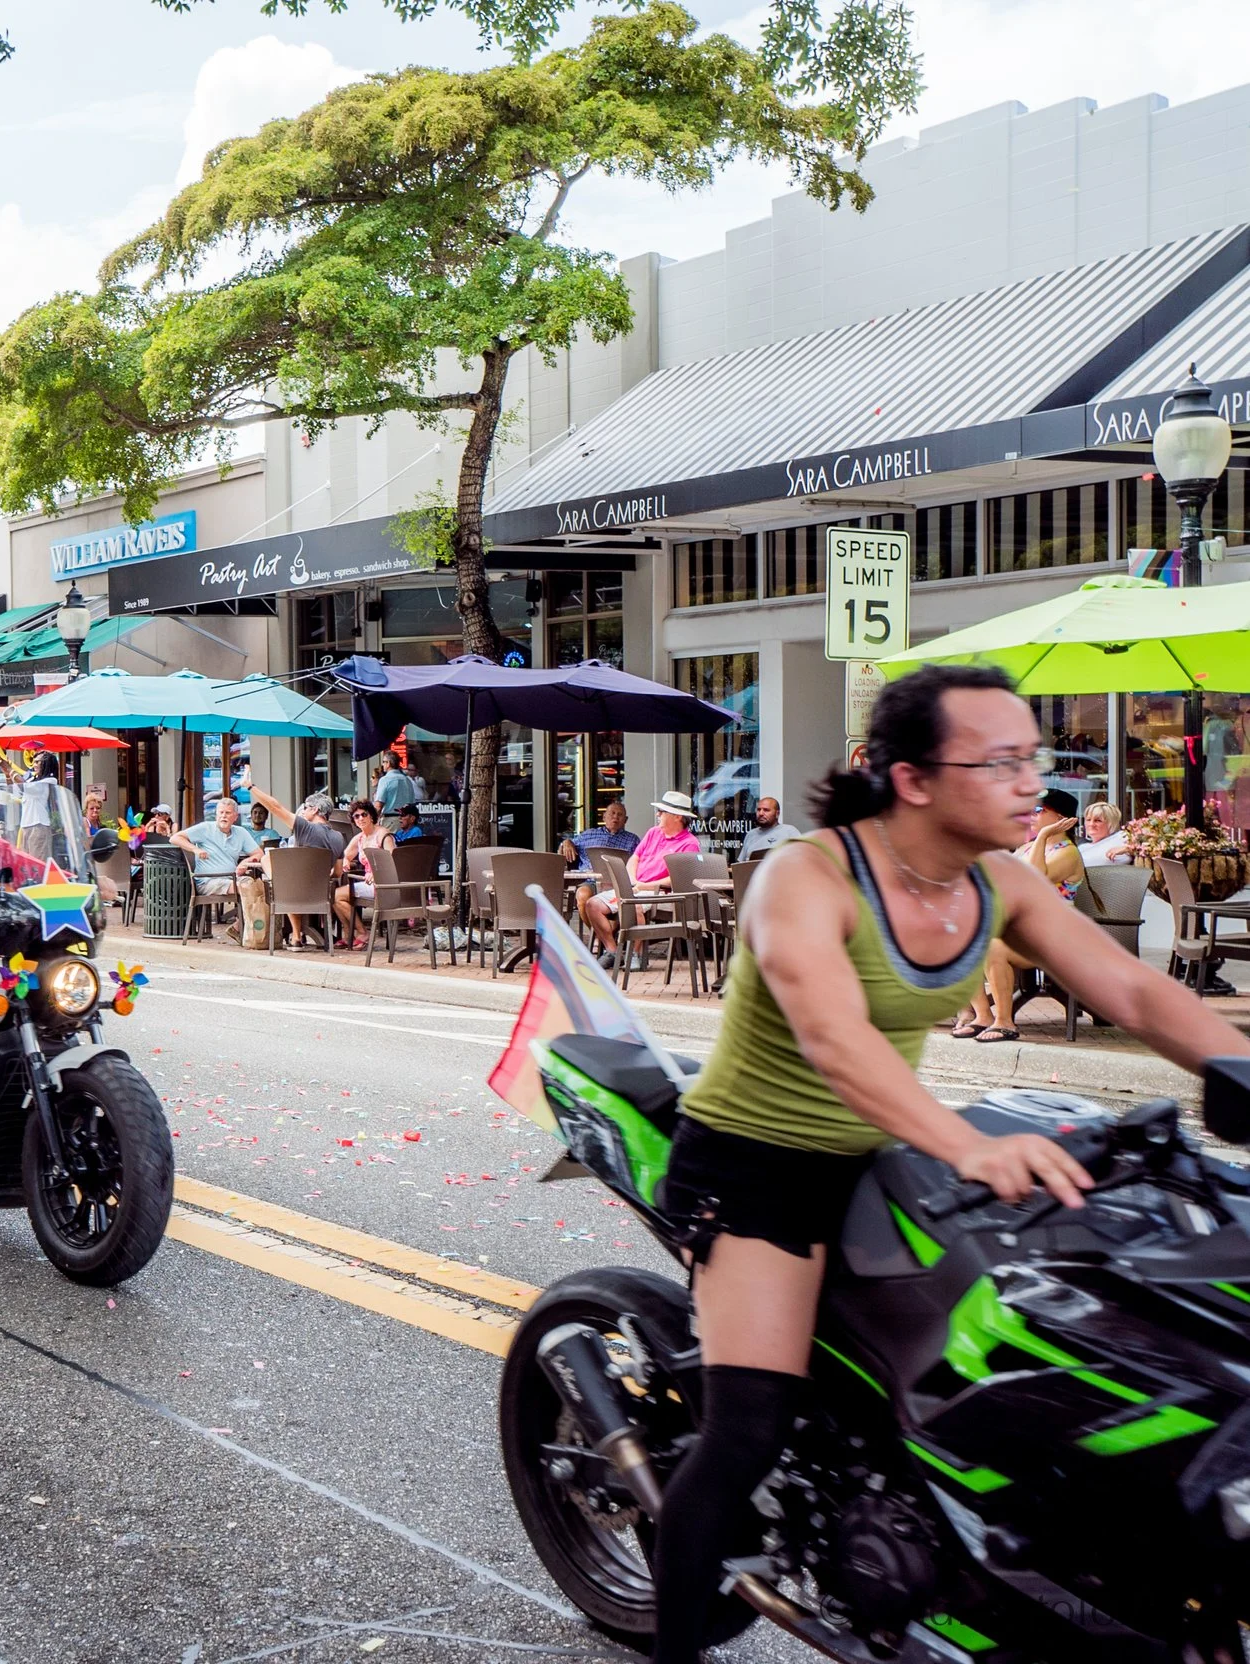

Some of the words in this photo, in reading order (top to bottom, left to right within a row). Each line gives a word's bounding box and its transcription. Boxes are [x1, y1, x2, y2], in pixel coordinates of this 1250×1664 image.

[1094, 403, 1152, 446] SARA
[786, 459, 830, 497] SARA
[833, 446, 933, 490] CAMPBELL
[557, 503, 589, 535] SARA
[593, 495, 668, 529] CAMPBELL
[50, 535, 124, 573] WILLIAM
[835, 539, 901, 562] SPEED
[199, 561, 249, 594] Pastry
[253, 553, 282, 579] Art
[363, 559, 392, 574] sandwich
[843, 566, 894, 588] LIMIT
[844, 598, 892, 646] 15
[0, 668, 33, 688] Penzeys
[854, 678, 881, 687] LOADING
[862, 667, 874, 676] NO
[709, 816, 752, 834] CAMPBELL
